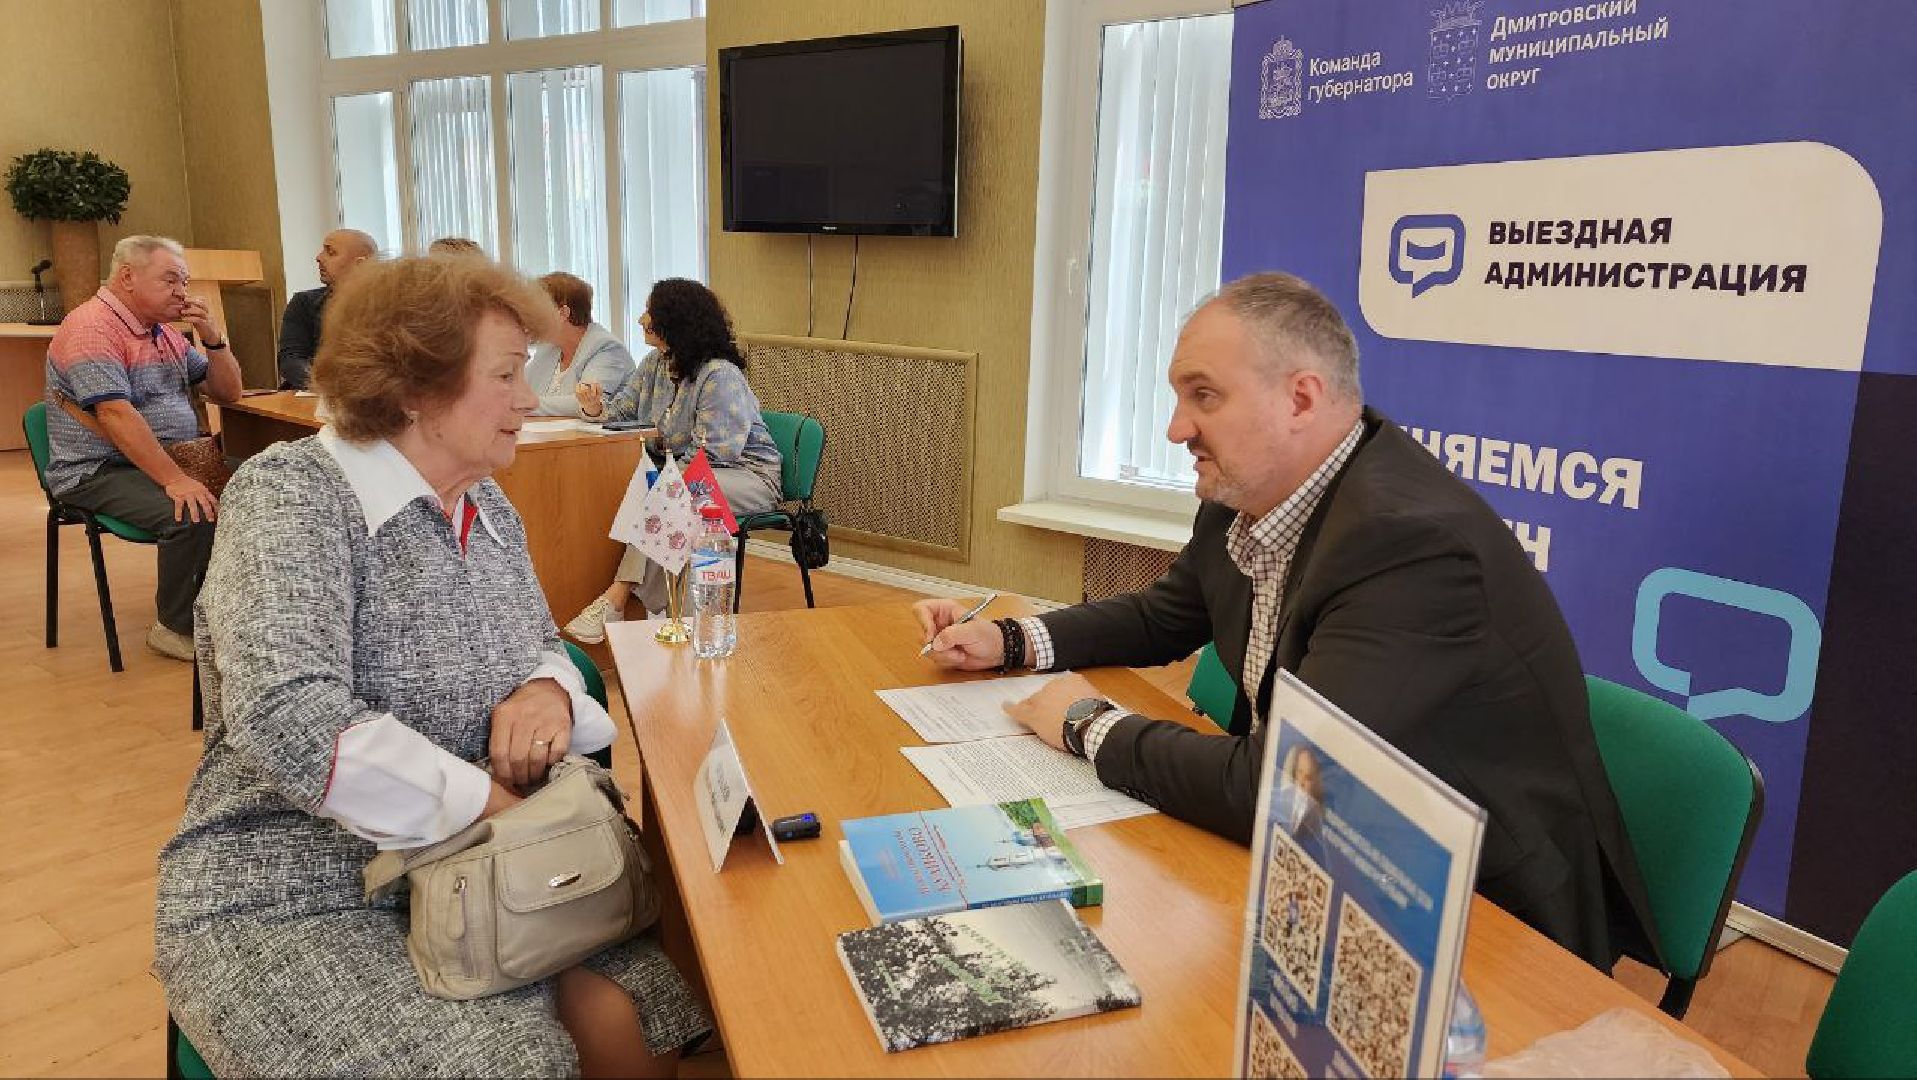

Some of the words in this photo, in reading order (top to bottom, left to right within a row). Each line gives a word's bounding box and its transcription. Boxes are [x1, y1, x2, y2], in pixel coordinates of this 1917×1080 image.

[1488, 16, 1669, 64] МУНИЦИПАЛЬНЫЙ
[1309, 51, 1381, 77] Команда
[1486, 67, 1541, 90] ОКРУГ
[1307, 71, 1413, 104] губернатора
[1488, 217, 1672, 249] ВЫЕЗДНАЯ
[1484, 260, 1808, 297] АДМИНИСТРАЦИЯ
[1400, 425, 1643, 510] ЯЕМСЯ
